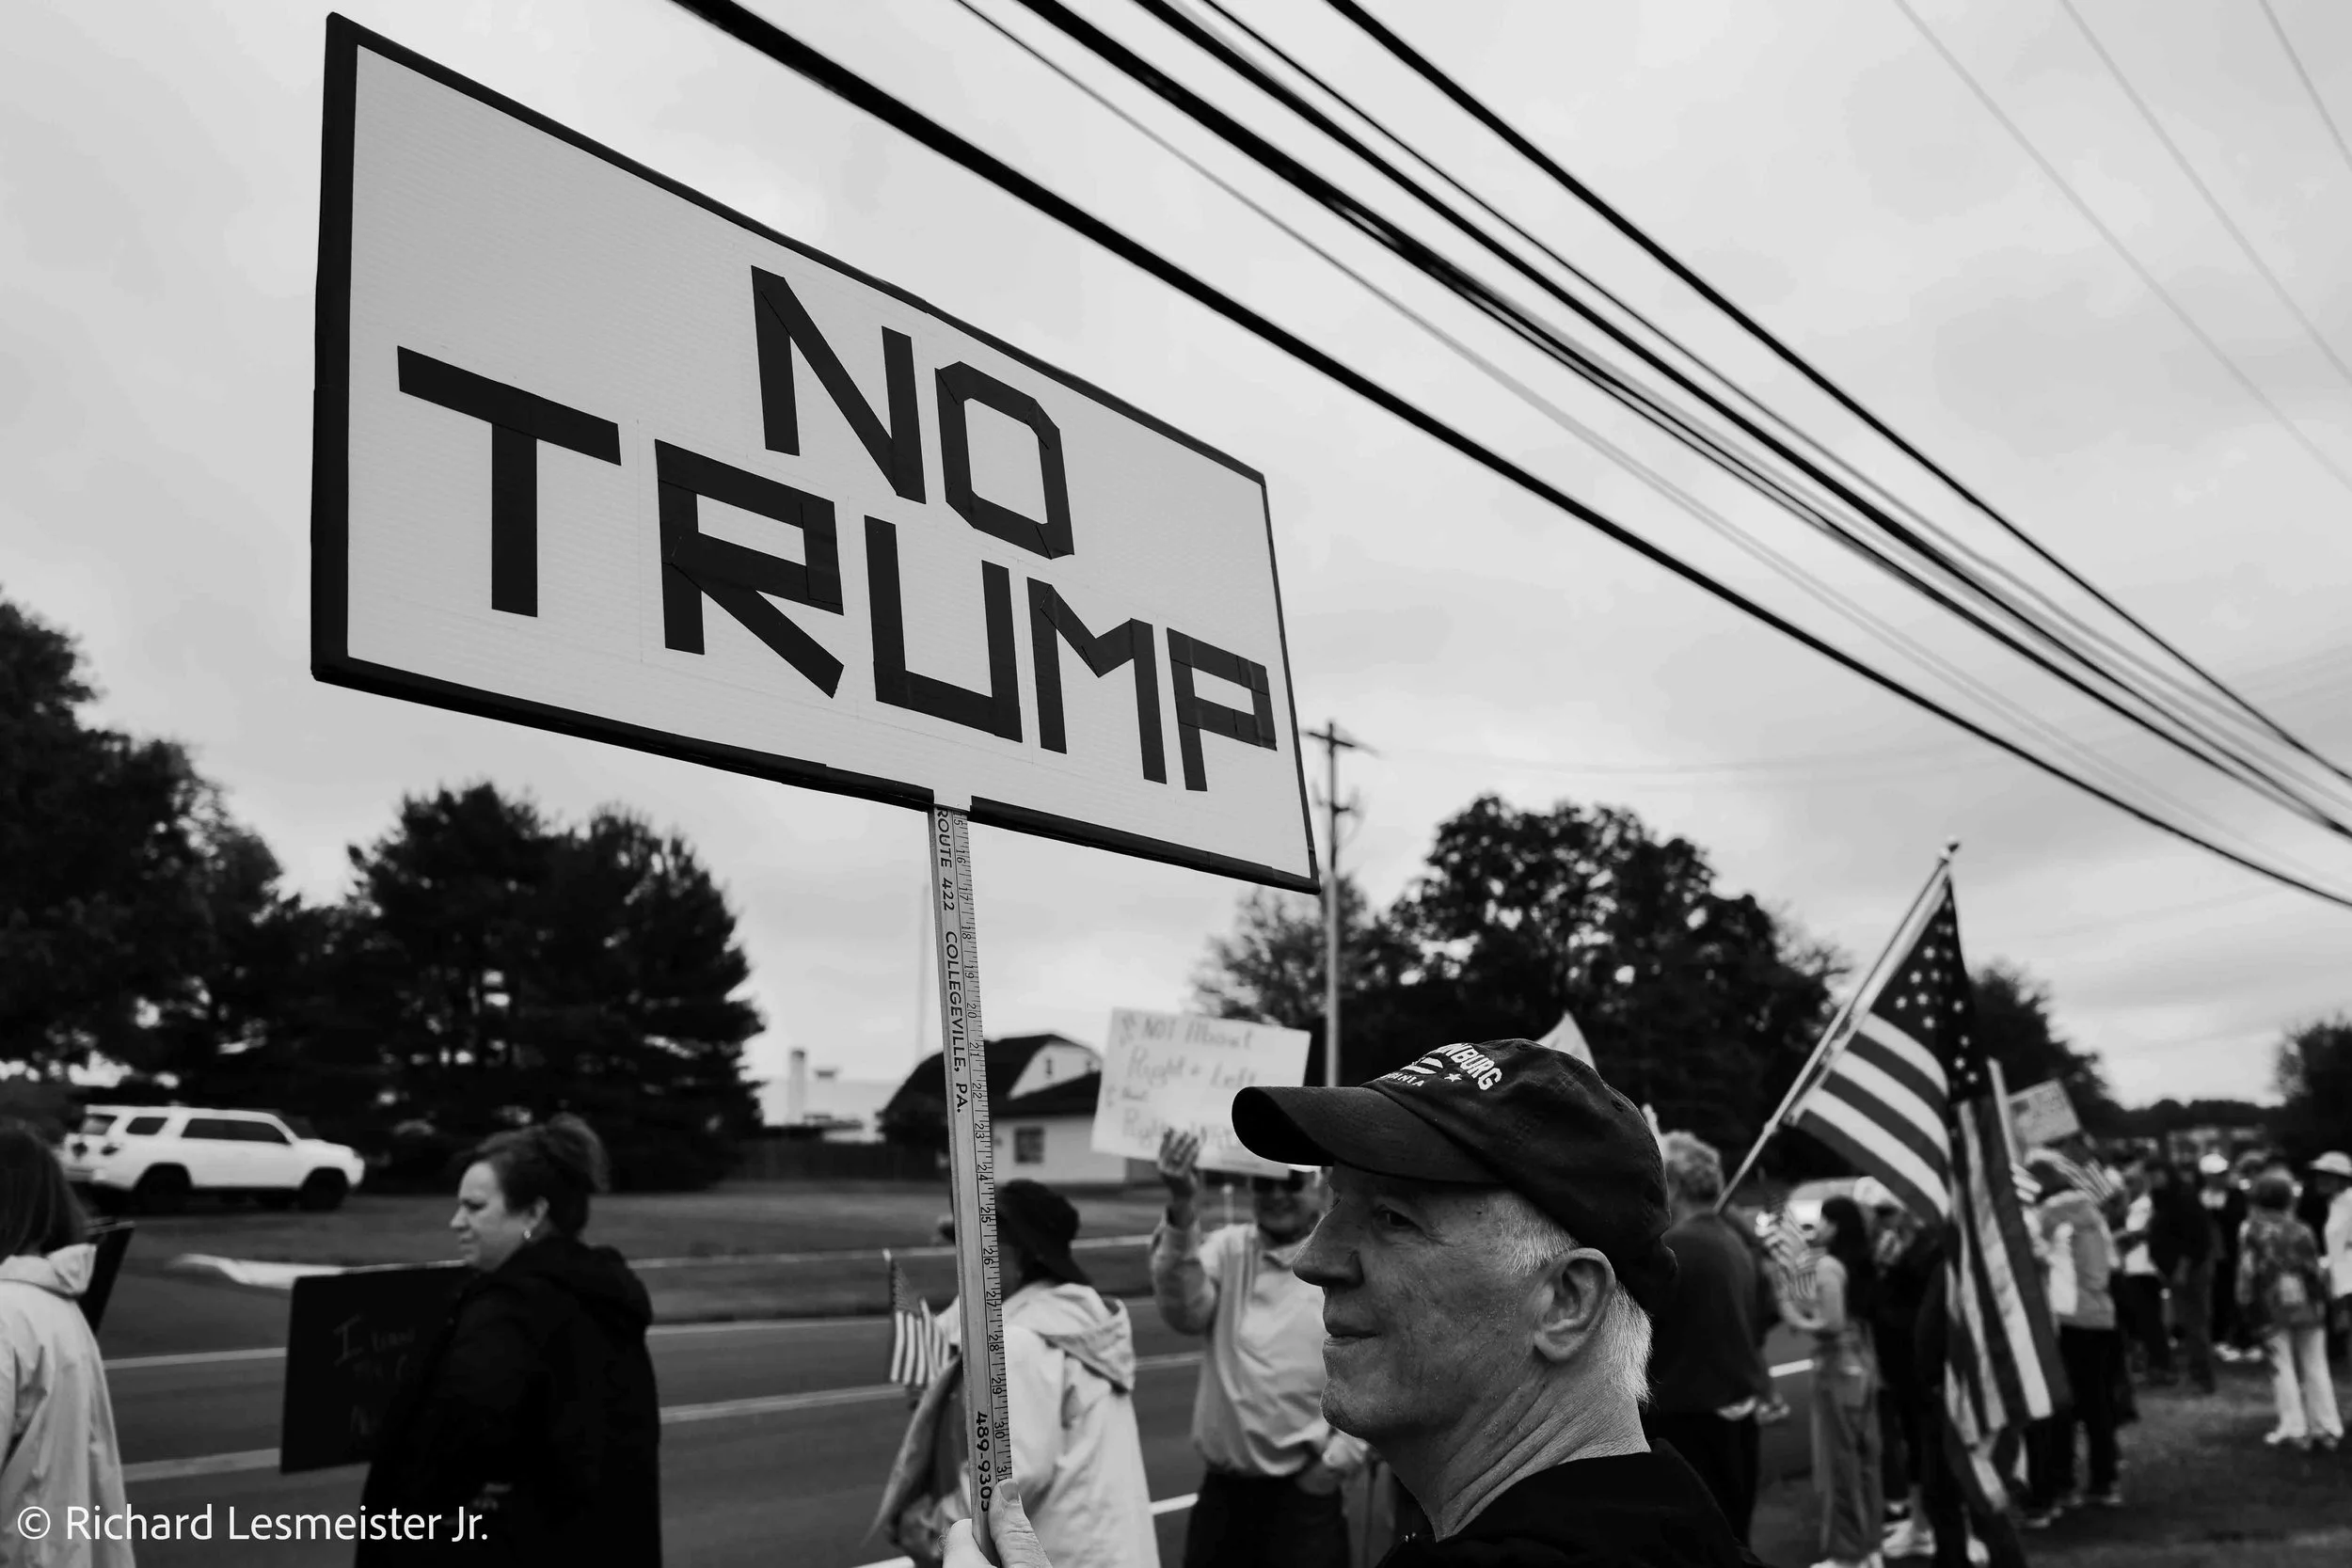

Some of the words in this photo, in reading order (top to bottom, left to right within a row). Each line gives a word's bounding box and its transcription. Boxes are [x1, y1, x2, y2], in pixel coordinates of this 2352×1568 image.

[751, 265, 1074, 560] NO
[397, 345, 1278, 792] TRUMP
[937, 807, 952, 868] ROUTE
[956, 849, 966, 863] 16
[942, 878, 955, 911] 422
[959, 887, 969, 901] 17
[961, 926, 972, 940] 18
[964, 965, 975, 979] 19
[946, 931, 966, 1072] COLLEGEVILLE,
[967, 1003, 977, 1019] 20
[970, 1042, 979, 1056] 21
[956, 1083, 968, 1113] PA.
[972, 1083, 982, 1099] 22
[975, 1122, 985, 1139] 23
[977, 1164, 989, 1181] 24
[980, 1206, 991, 1223] 25
[983, 1247, 994, 1265] 26
[986, 1291, 997, 1307] 27
[989, 1334, 1000, 1352] 28
[992, 1377, 1003, 1395] 29
[994, 1421, 1006, 1439] 30
